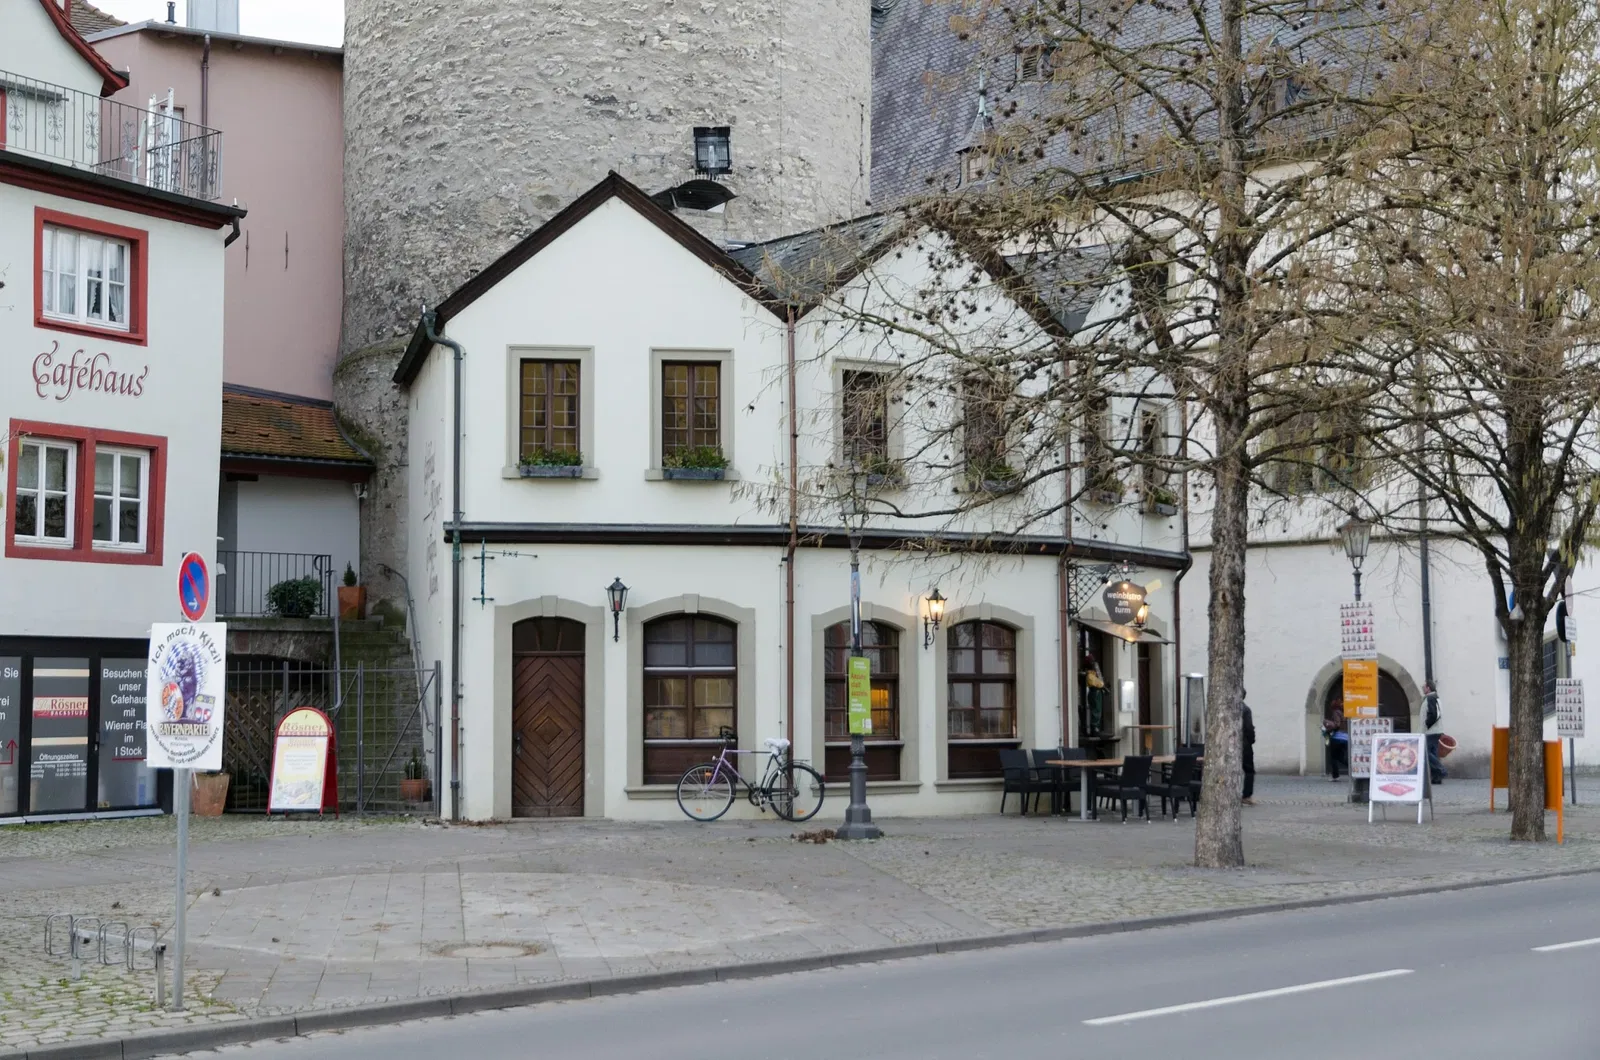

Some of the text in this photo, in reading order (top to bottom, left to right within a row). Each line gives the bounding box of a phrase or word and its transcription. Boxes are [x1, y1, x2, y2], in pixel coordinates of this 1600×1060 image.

[33, 340, 150, 401] Caféhaus
[1107, 592, 1142, 600] weinbistro
[152, 643, 165, 664] Ich
[166, 625, 196, 642] moch
[4, 667, 19, 678] Sie
[102, 668, 143, 678] Besuchen
[119, 683, 142, 691] unser
[111, 694, 148, 704] Cafehaus
[51, 699, 87, 710] Rösner
[123, 707, 136, 717] mit
[105, 720, 134, 731] Wiener
[124, 733, 134, 743] im
[120, 746, 143, 756] Stock
